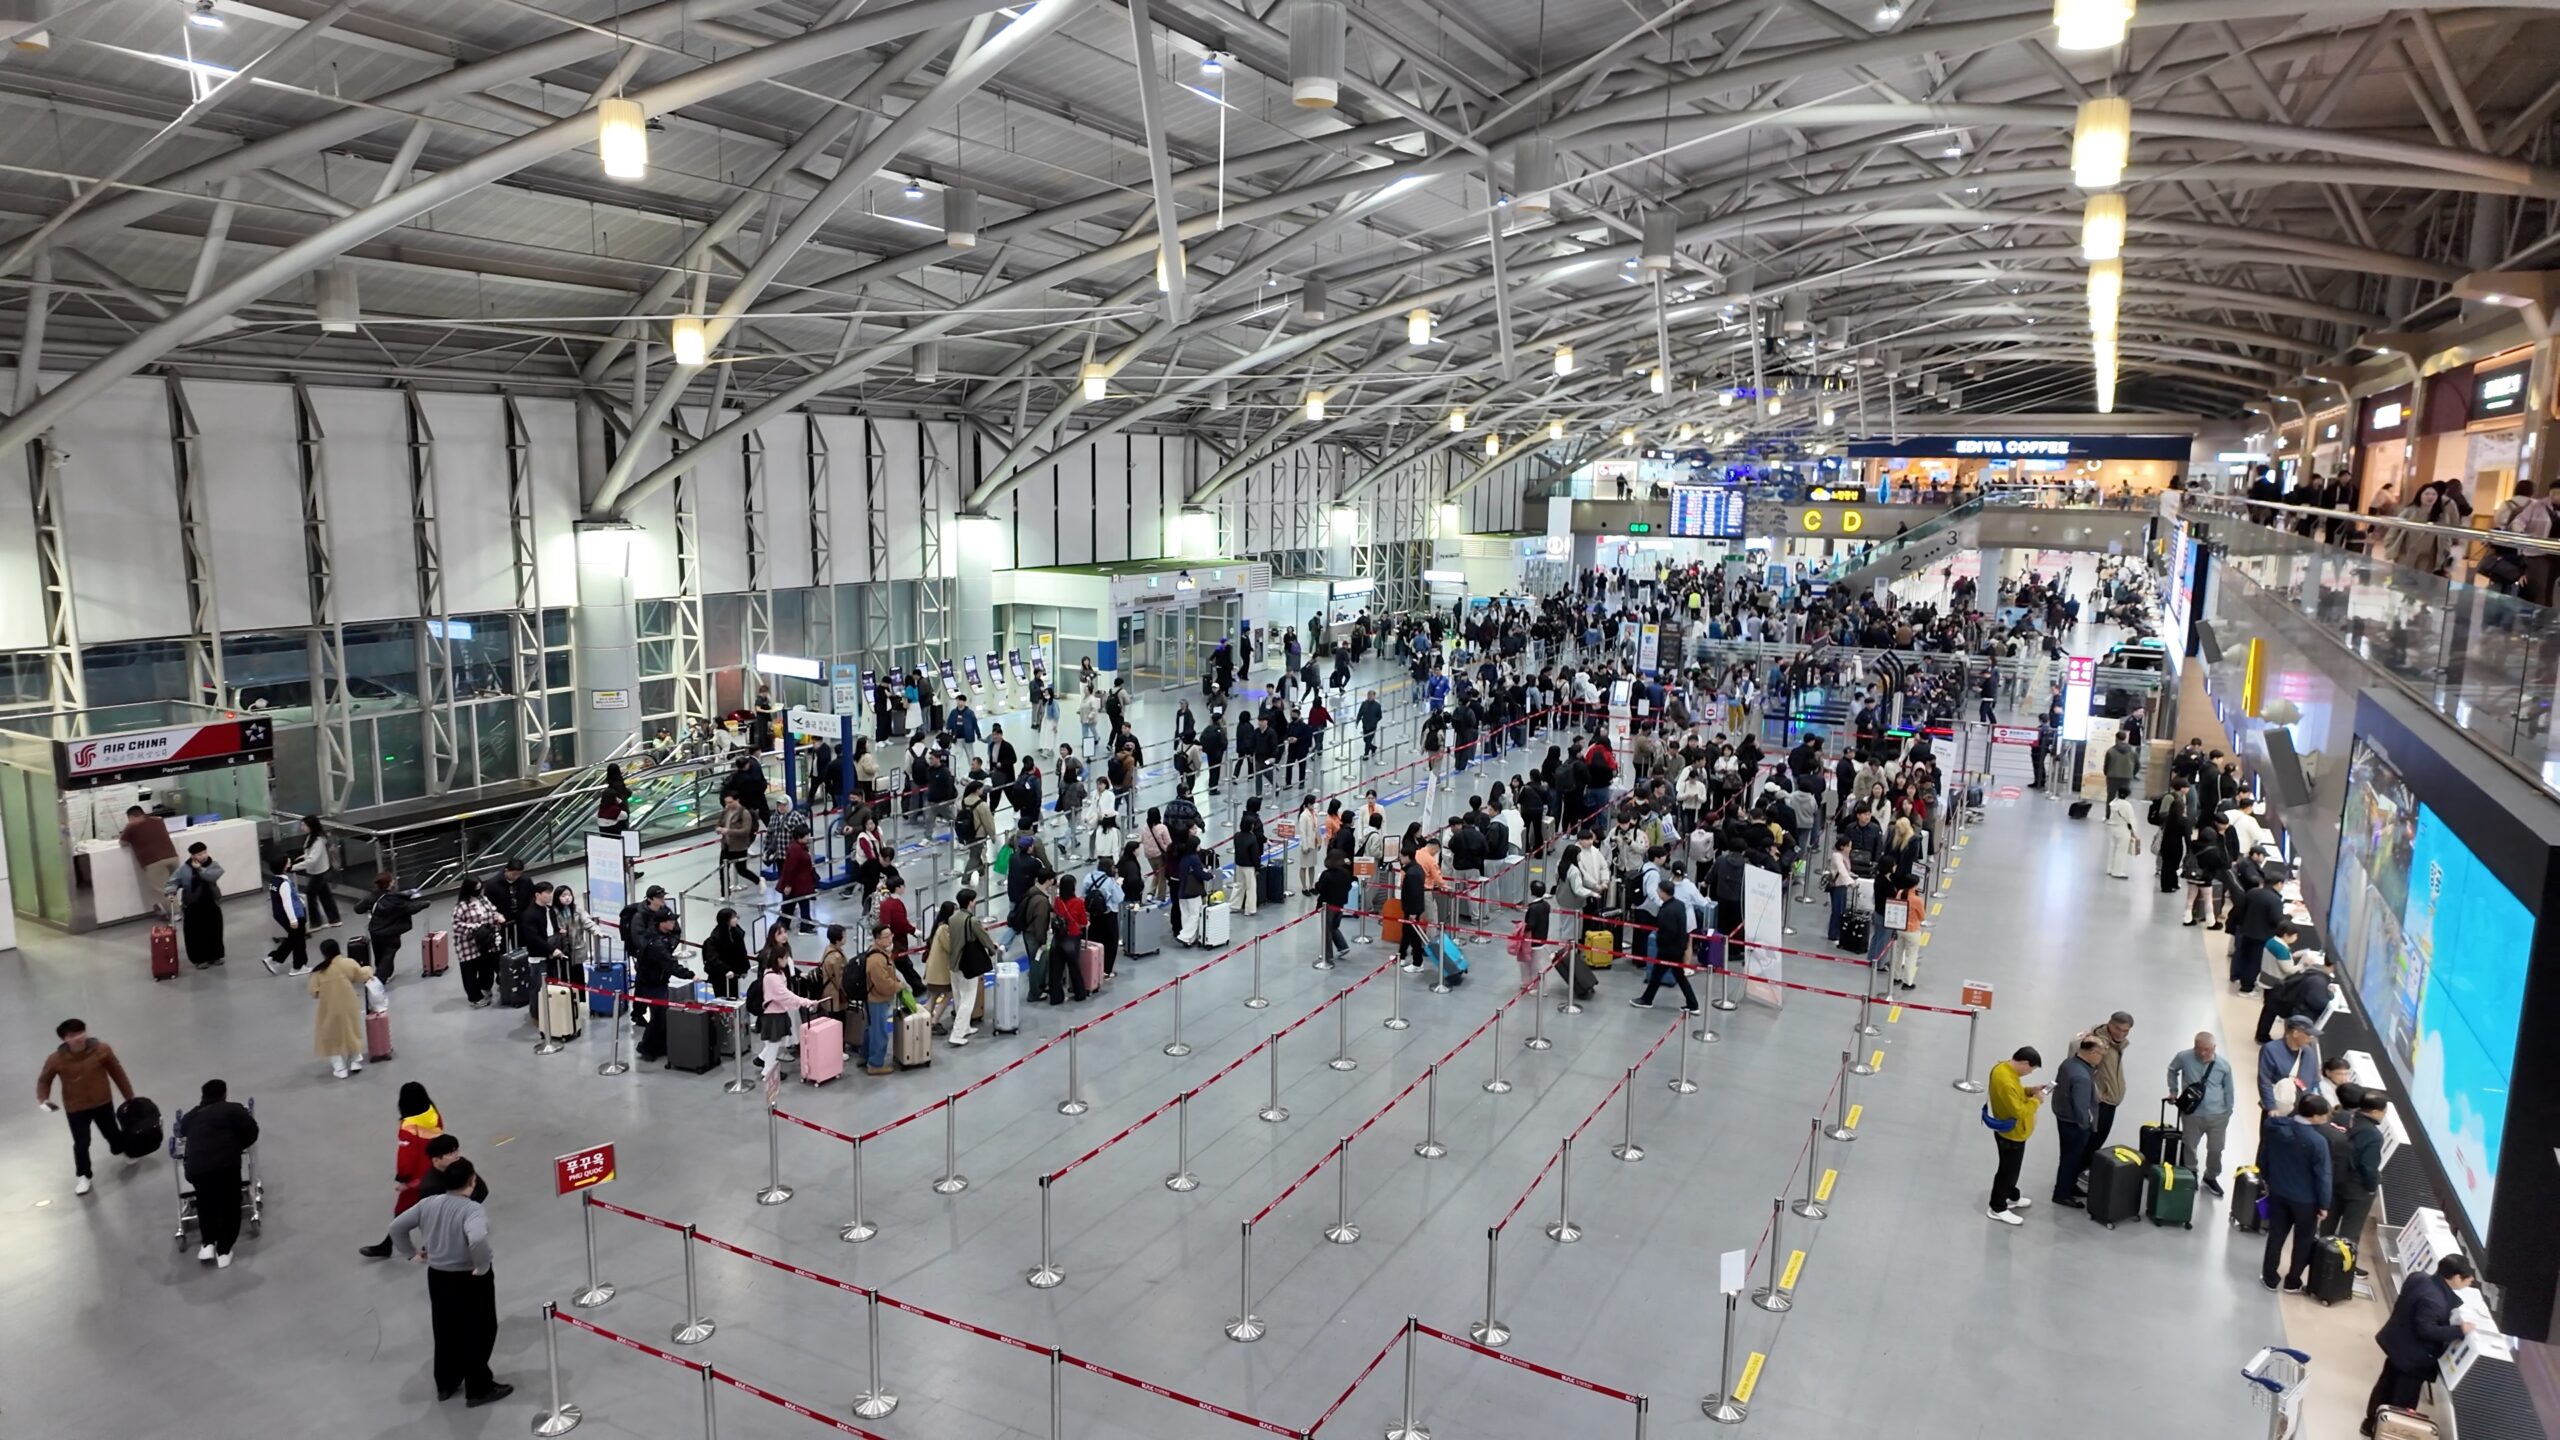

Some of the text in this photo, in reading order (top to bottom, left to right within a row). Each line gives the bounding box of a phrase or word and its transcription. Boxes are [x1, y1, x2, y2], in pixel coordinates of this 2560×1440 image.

[1956, 440, 2070, 454] EDIYA COFFEE
[1803, 510, 1862, 532] C D
[1900, 530, 1958, 570] 2 3
[103, 737, 167, 754] AIR CHINA
[566, 1152, 605, 1174] 푸꾸옥
[568, 1166, 604, 1181] PHU QUOC
